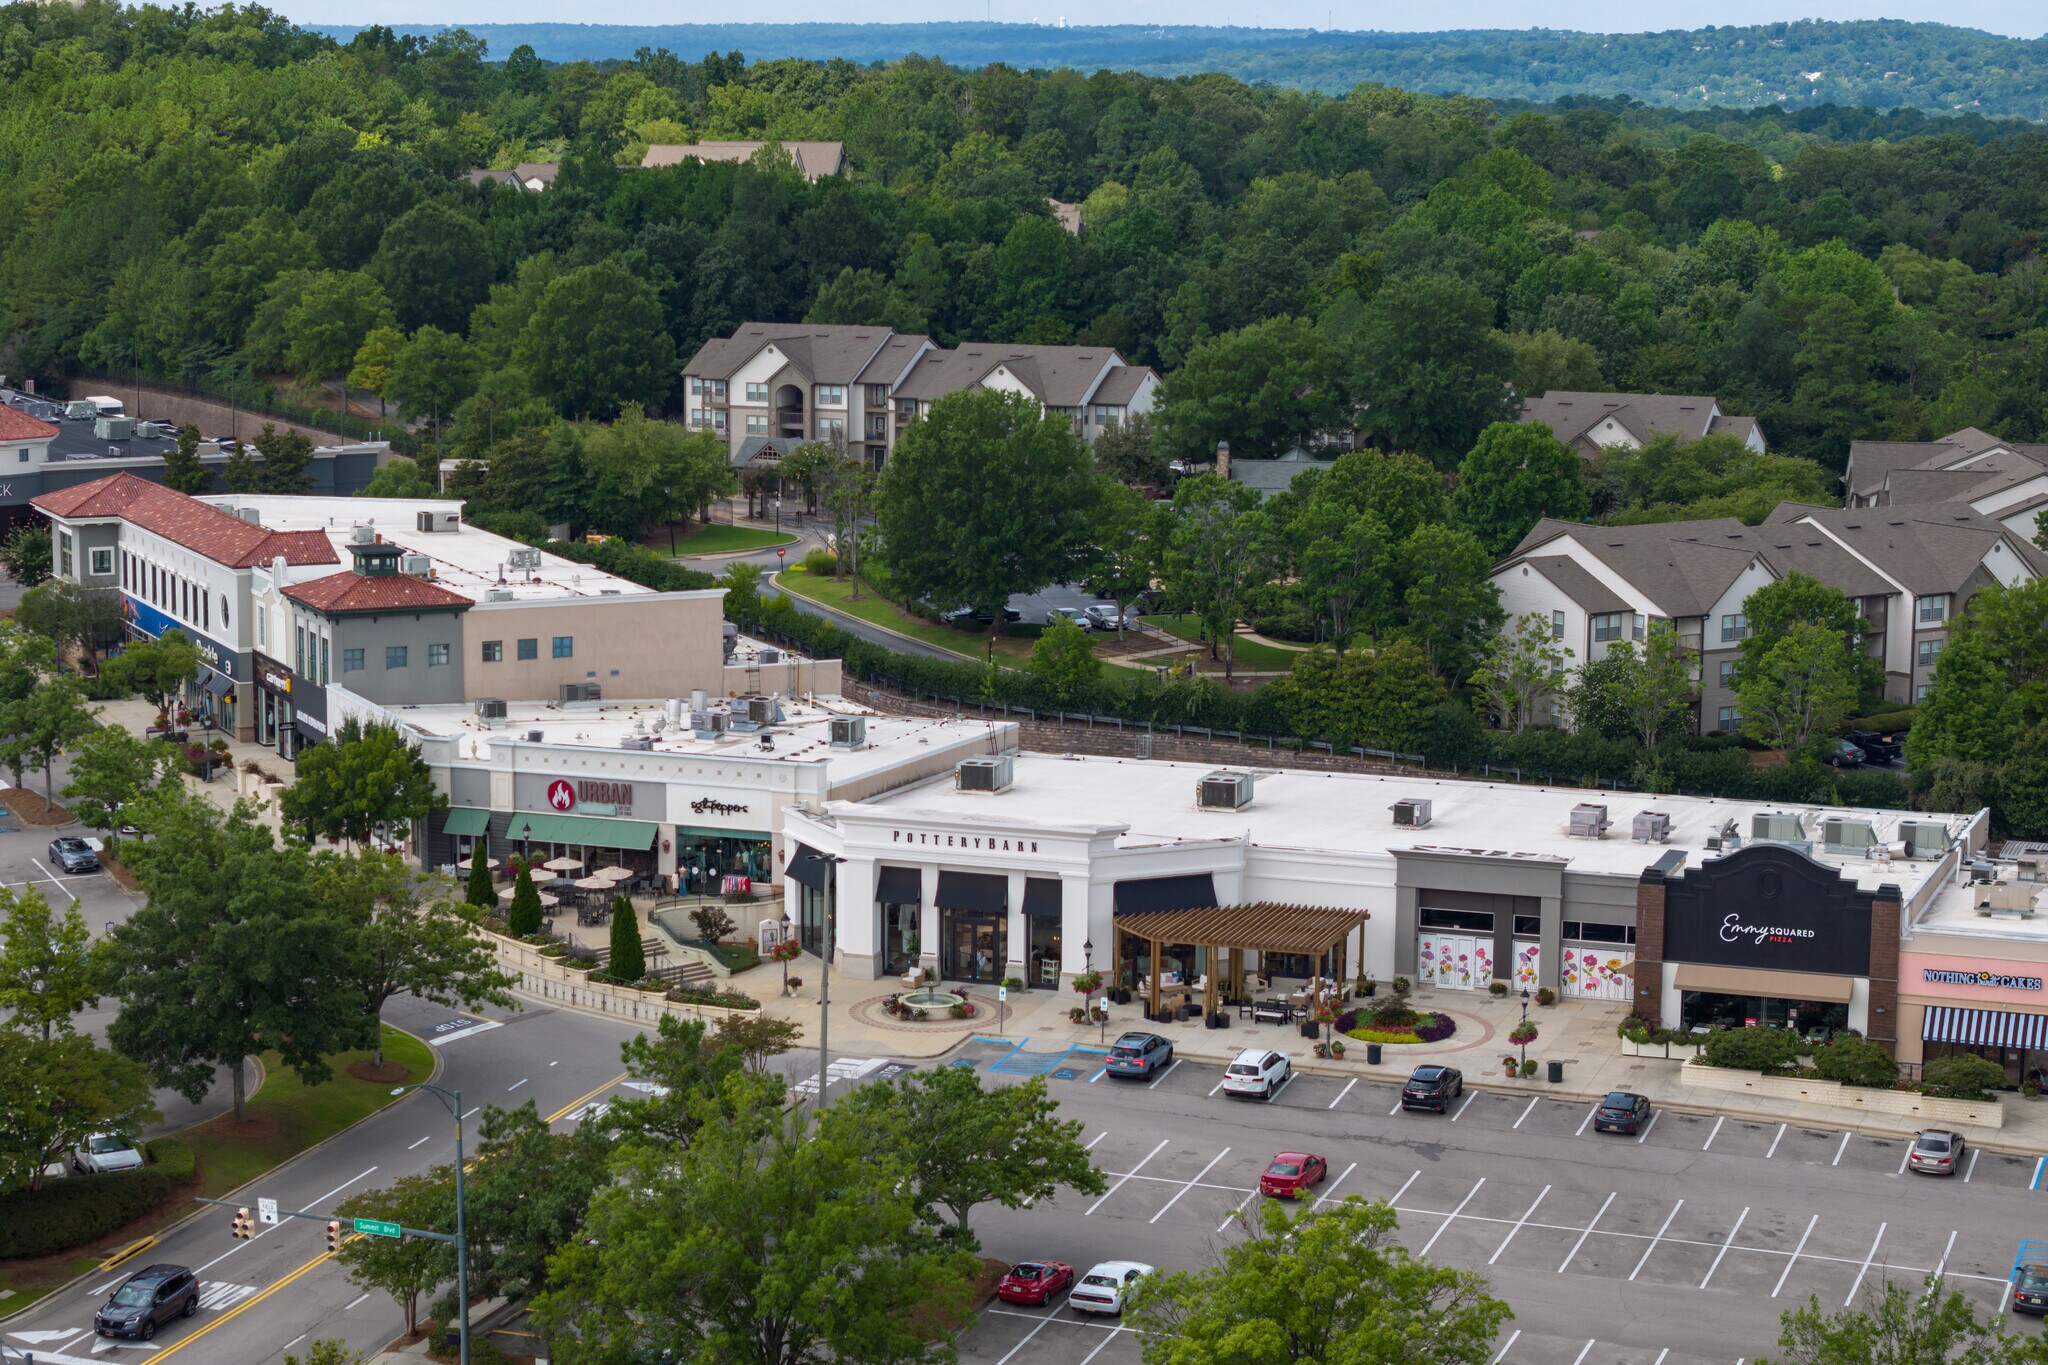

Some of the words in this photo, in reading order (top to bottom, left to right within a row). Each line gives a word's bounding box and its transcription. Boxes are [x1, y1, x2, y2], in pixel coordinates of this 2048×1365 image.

[578, 780, 632, 806] URBAN
[1719, 913, 1769, 945] Emmy
[1769, 926, 1815, 938] SQUARED
[1769, 936, 1793, 944] PIZZA
[1923, 969, 1975, 985] NOTHING
[2000, 975, 2042, 990] CAKES
[435, 1019, 472, 1032] STOP
[359, 1222, 380, 1231] Summit
[383, 1225, 396, 1234] Blvd
